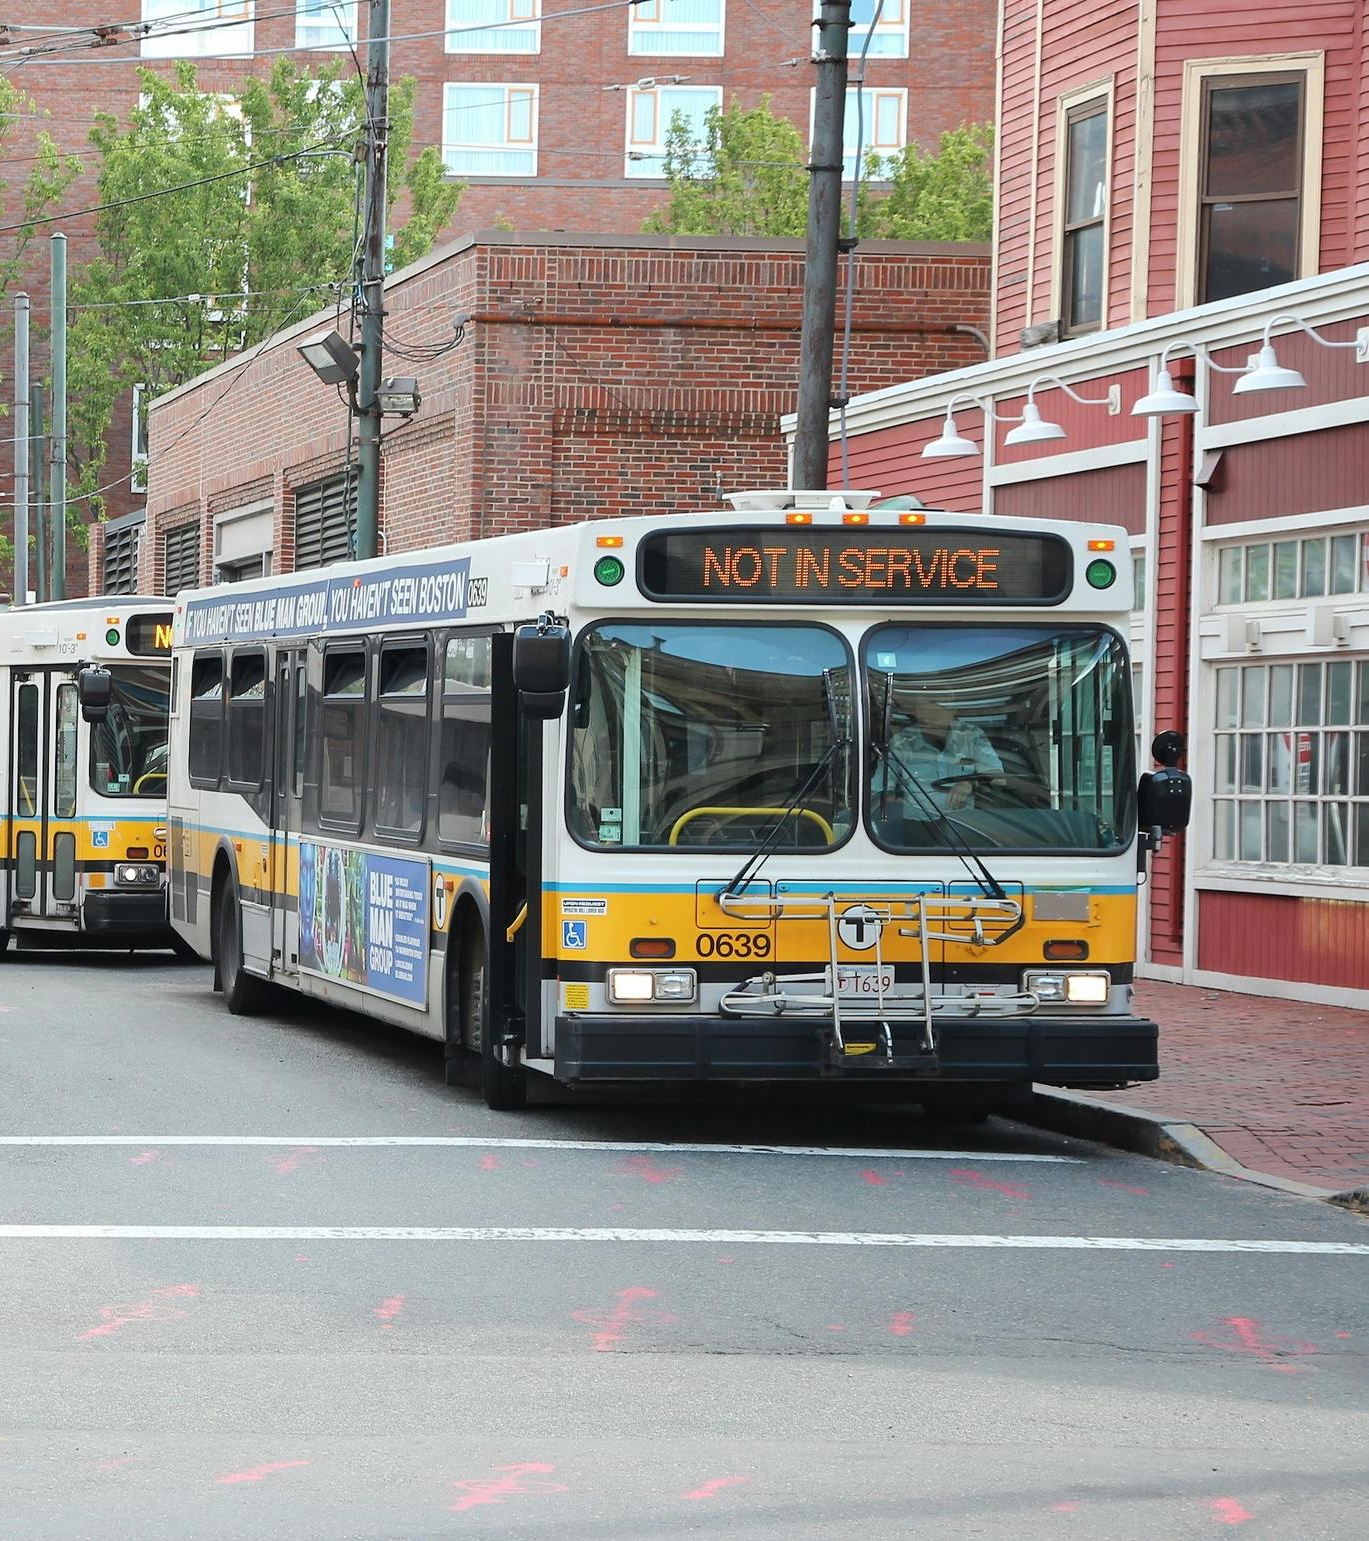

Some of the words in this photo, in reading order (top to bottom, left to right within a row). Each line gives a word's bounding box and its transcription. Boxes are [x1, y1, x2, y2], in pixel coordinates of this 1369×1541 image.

[704, 547, 787, 587] NOT
[795, 547, 830, 588] IN
[838, 548, 1000, 588] SERVICE
[193, 608, 207, 637] YOU
[206, 604, 236, 636] HAVEN'T
[235, 602, 255, 633] SEEN
[254, 599, 277, 632] BLUE
[276, 596, 297, 629] MAN
[331, 588, 352, 622] YOU
[350, 580, 392, 621] HAVEN'T
[391, 577, 419, 615] SEEN
[418, 571, 466, 614] BOSTON
[468, 579, 487, 606] 0639
[370, 871, 393, 908] BLUE
[370, 906, 393, 948] MAN
[696, 933, 771, 958] 0639
[370, 945, 393, 975] GROUP
